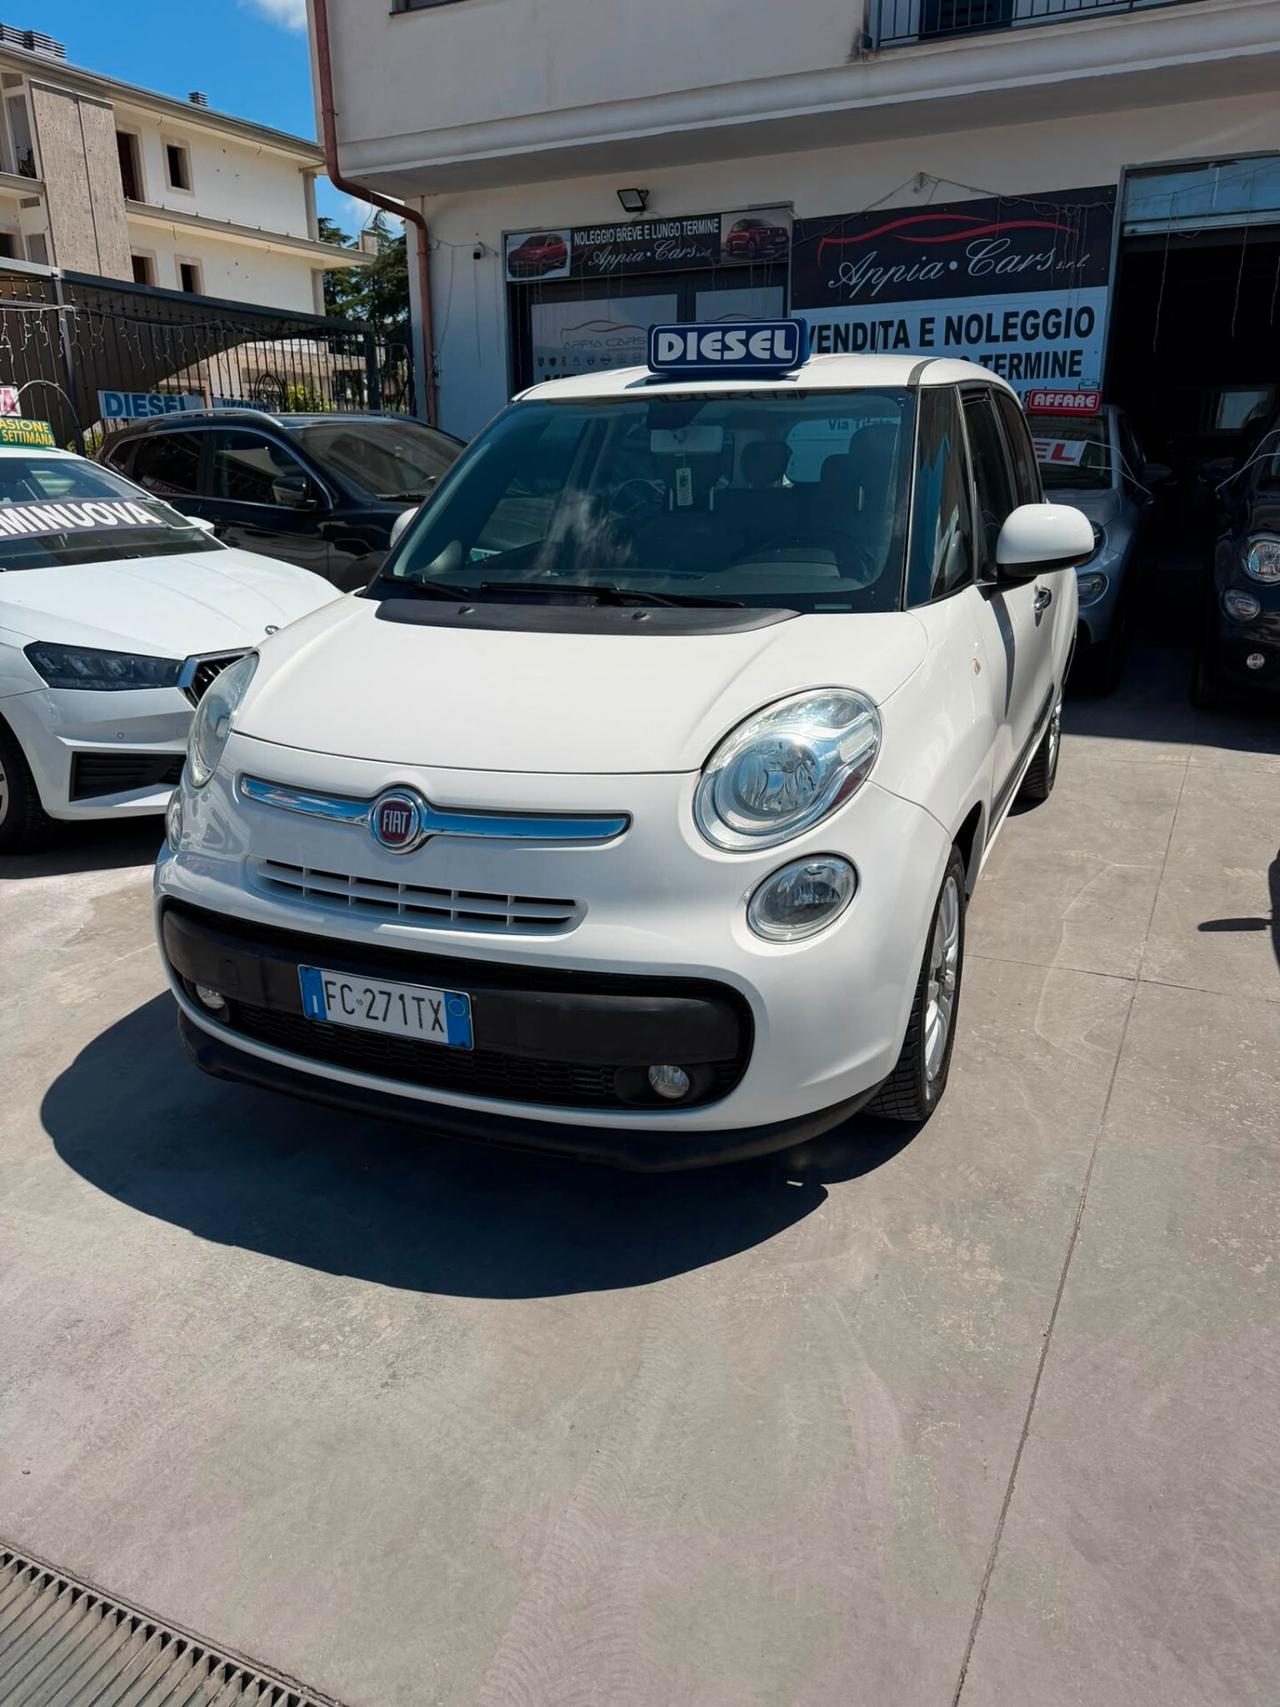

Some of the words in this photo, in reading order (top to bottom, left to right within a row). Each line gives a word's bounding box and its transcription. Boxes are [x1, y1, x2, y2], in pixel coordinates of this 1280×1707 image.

[574, 229, 615, 246] NOLEGGIO
[616, 226, 642, 242] BREVE
[644, 225, 650, 239] E
[652, 222, 680, 239] LUNGO
[682, 218, 719, 236] TERMINE
[588, 245, 645, 272] Appia
[828, 250, 944, 298] Appia
[965, 238, 1056, 277] Cars
[919, 316, 935, 347] E
[944, 305, 1096, 346] NOLEGGIO
[657, 329, 793, 362] DIESEL
[980, 349, 1083, 381] TERMINE
[103, 392, 187, 417] DIESEL
[1033, 393, 1096, 408] AFFARE
[2, 430, 56, 446] SETTIMANA
[0, 502, 162, 536] MINUOVA
[382, 809, 409, 834] FIAT
